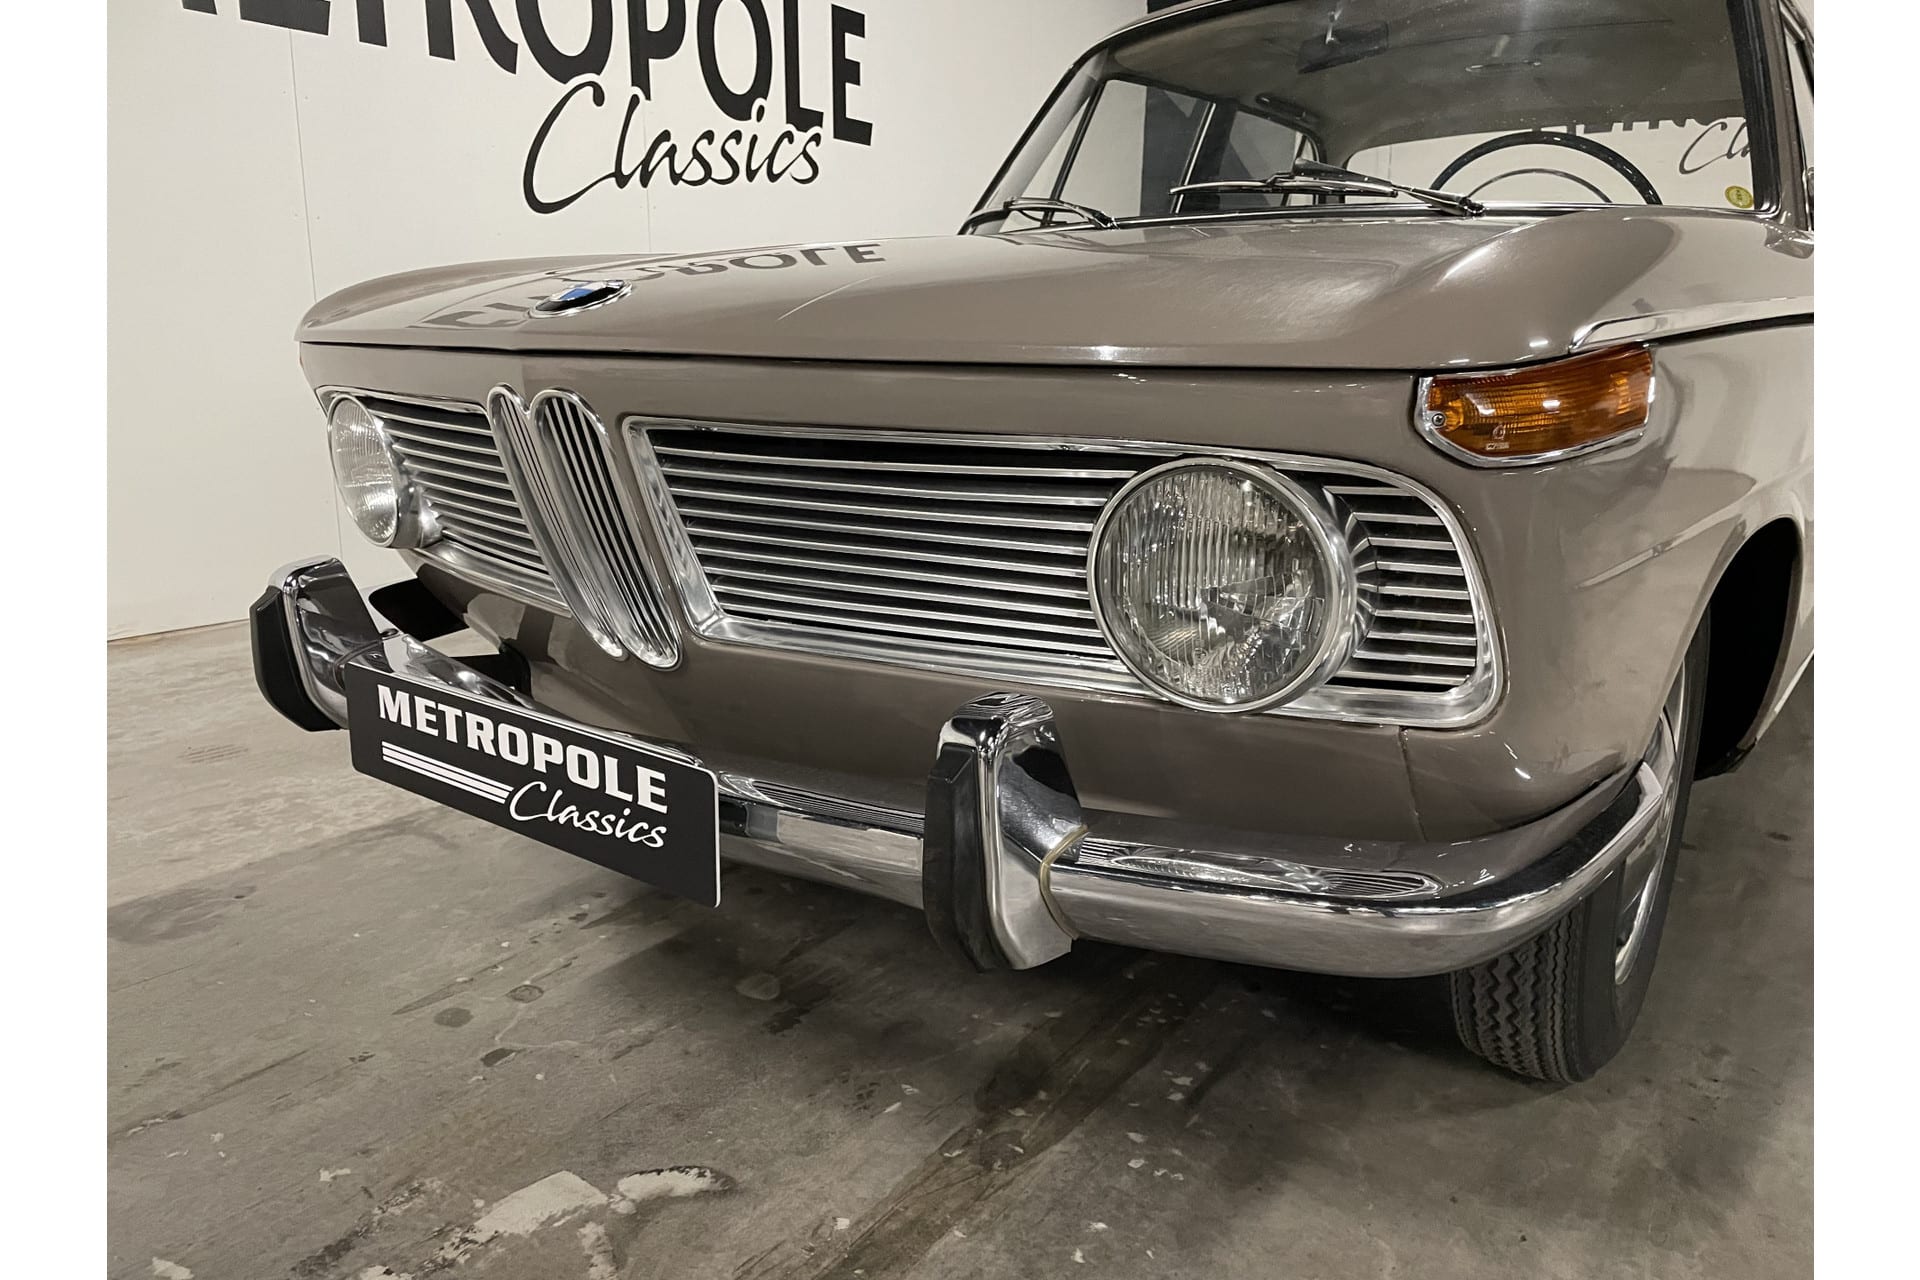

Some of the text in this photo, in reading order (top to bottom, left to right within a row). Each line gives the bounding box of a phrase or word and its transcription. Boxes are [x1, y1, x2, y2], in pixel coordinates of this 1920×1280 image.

[181, 0, 873, 146] OPOLE
[523, 80, 822, 214] Classics
[377, 684, 668, 814] METROPOLE
[509, 781, 668, 848] Classics
